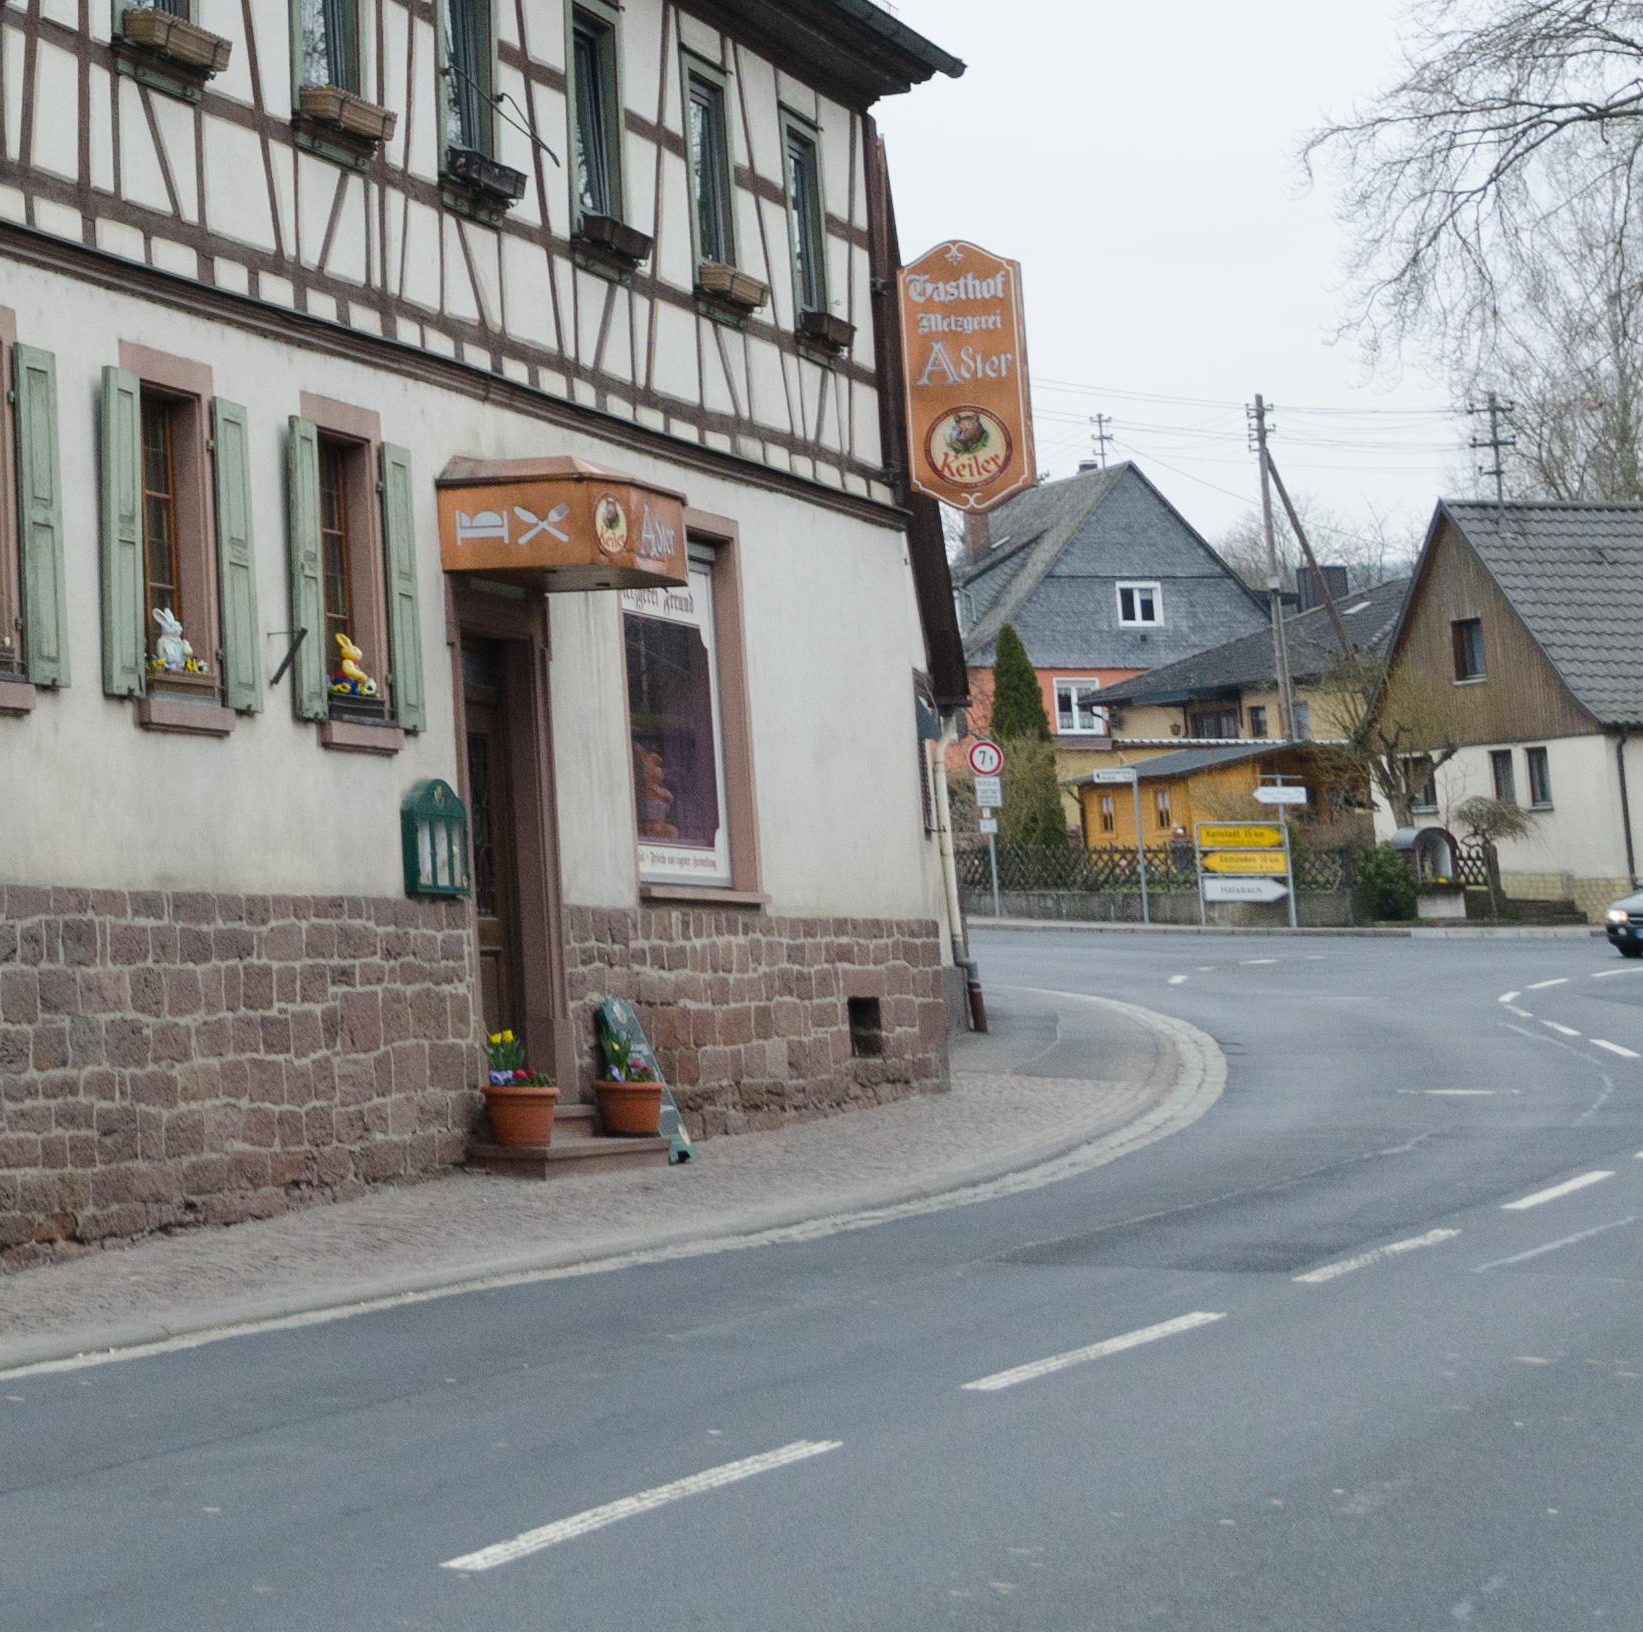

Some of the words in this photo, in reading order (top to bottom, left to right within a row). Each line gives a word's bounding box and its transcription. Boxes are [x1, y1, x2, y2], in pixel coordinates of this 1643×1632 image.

[905, 270, 1006, 304] Gasthof
[918, 310, 1002, 334] Metzgerei
[916, 340, 1013, 386] Adler
[940, 452, 1003, 478] Keiler
[639, 499, 675, 559] Adler
